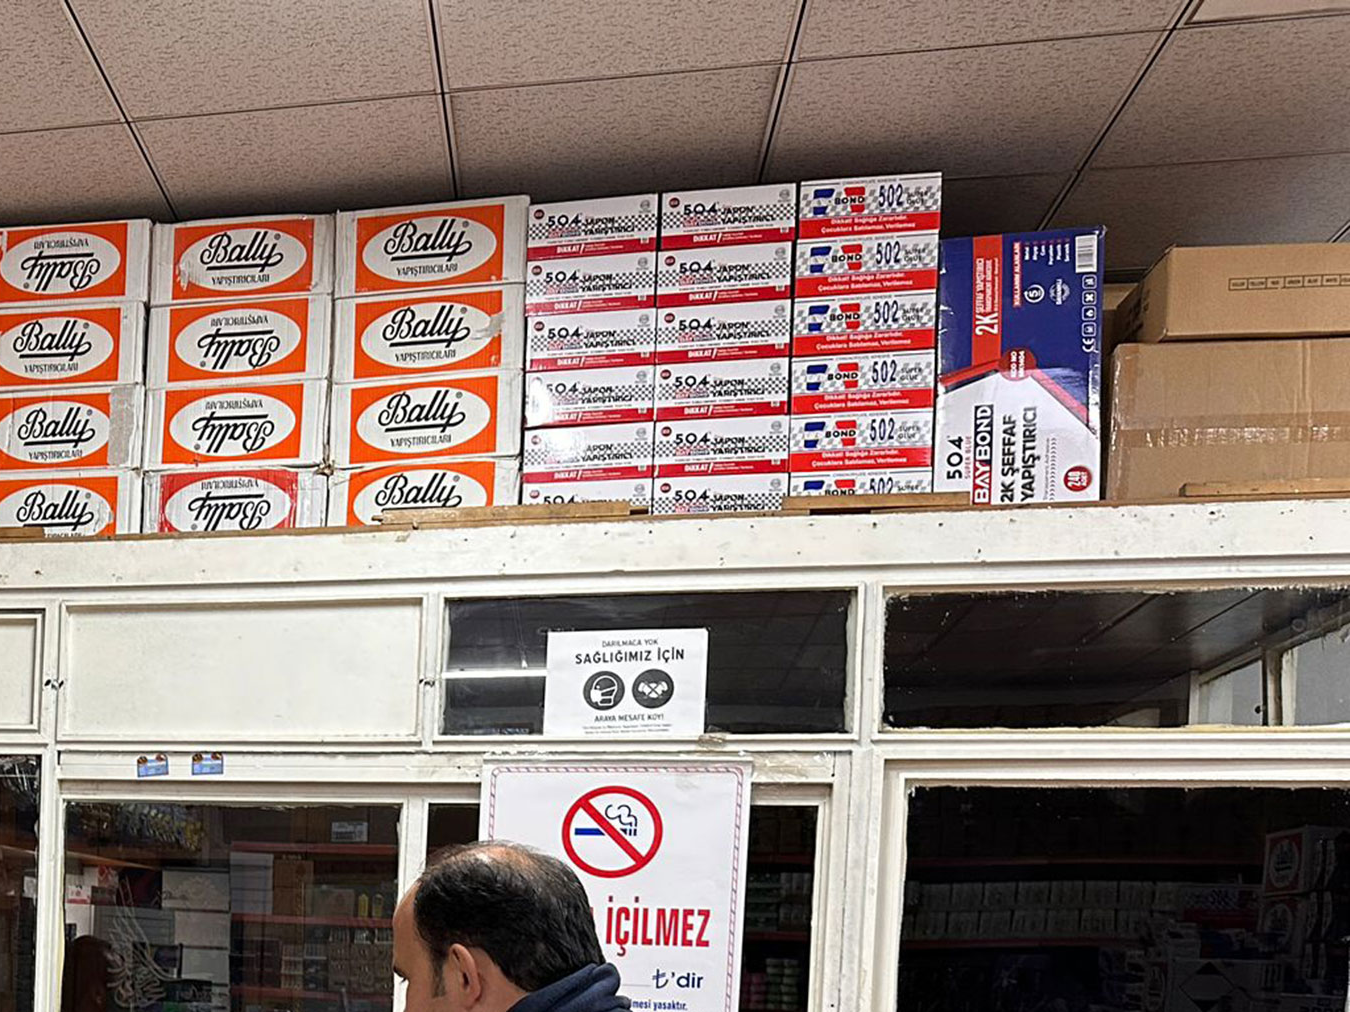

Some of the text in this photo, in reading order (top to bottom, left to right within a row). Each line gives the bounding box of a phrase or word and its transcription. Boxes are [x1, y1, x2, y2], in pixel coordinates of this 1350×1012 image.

[834, 184, 904, 207] BOND 502
[547, 212, 581, 227] 504
[683, 202, 718, 215] 504
[199, 230, 284, 272] Bally
[383, 218, 472, 262] Bally
[831, 241, 900, 265] BOND 502
[20, 250, 101, 292] Bally
[545, 269, 580, 283] 504
[679, 261, 713, 273] 504
[829, 300, 899, 324] BOND 502
[975, 312, 998, 335] 2K
[381, 304, 470, 348] Bally
[547, 326, 582, 339] 504
[678, 318, 713, 331] 504
[12, 319, 92, 361] Bally
[196, 327, 281, 370] Bally
[675, 374, 710, 388] 504
[827, 359, 897, 383] BOND 502
[377, 390, 467, 434] Bally
[17, 405, 96, 448] Bally
[191, 411, 275, 454] Bally
[675, 432, 710, 445] 504
[825, 418, 895, 441] BOND 502
[947, 435, 963, 480] 504
[974, 405, 994, 504] BAYBOND
[1001, 414, 1020, 503] 2K ŞEFFAF
[1021, 406, 1041, 503] YAPIŞTIRICI
[374, 472, 463, 510] Bally
[675, 489, 710, 502] 504
[868, 477, 894, 494] 502
[16, 489, 95, 528] Bally
[544, 493, 578, 504] 504
[187, 491, 271, 531] Bally
[575, 646, 685, 665] SAĞLIĞIMIZ İÇİN
[594, 712, 664, 723] ARAYA MESAFE KOY!
[605, 895, 711, 957] İÇİLMEZ
[653, 999, 688, 1012] yasaktır.
